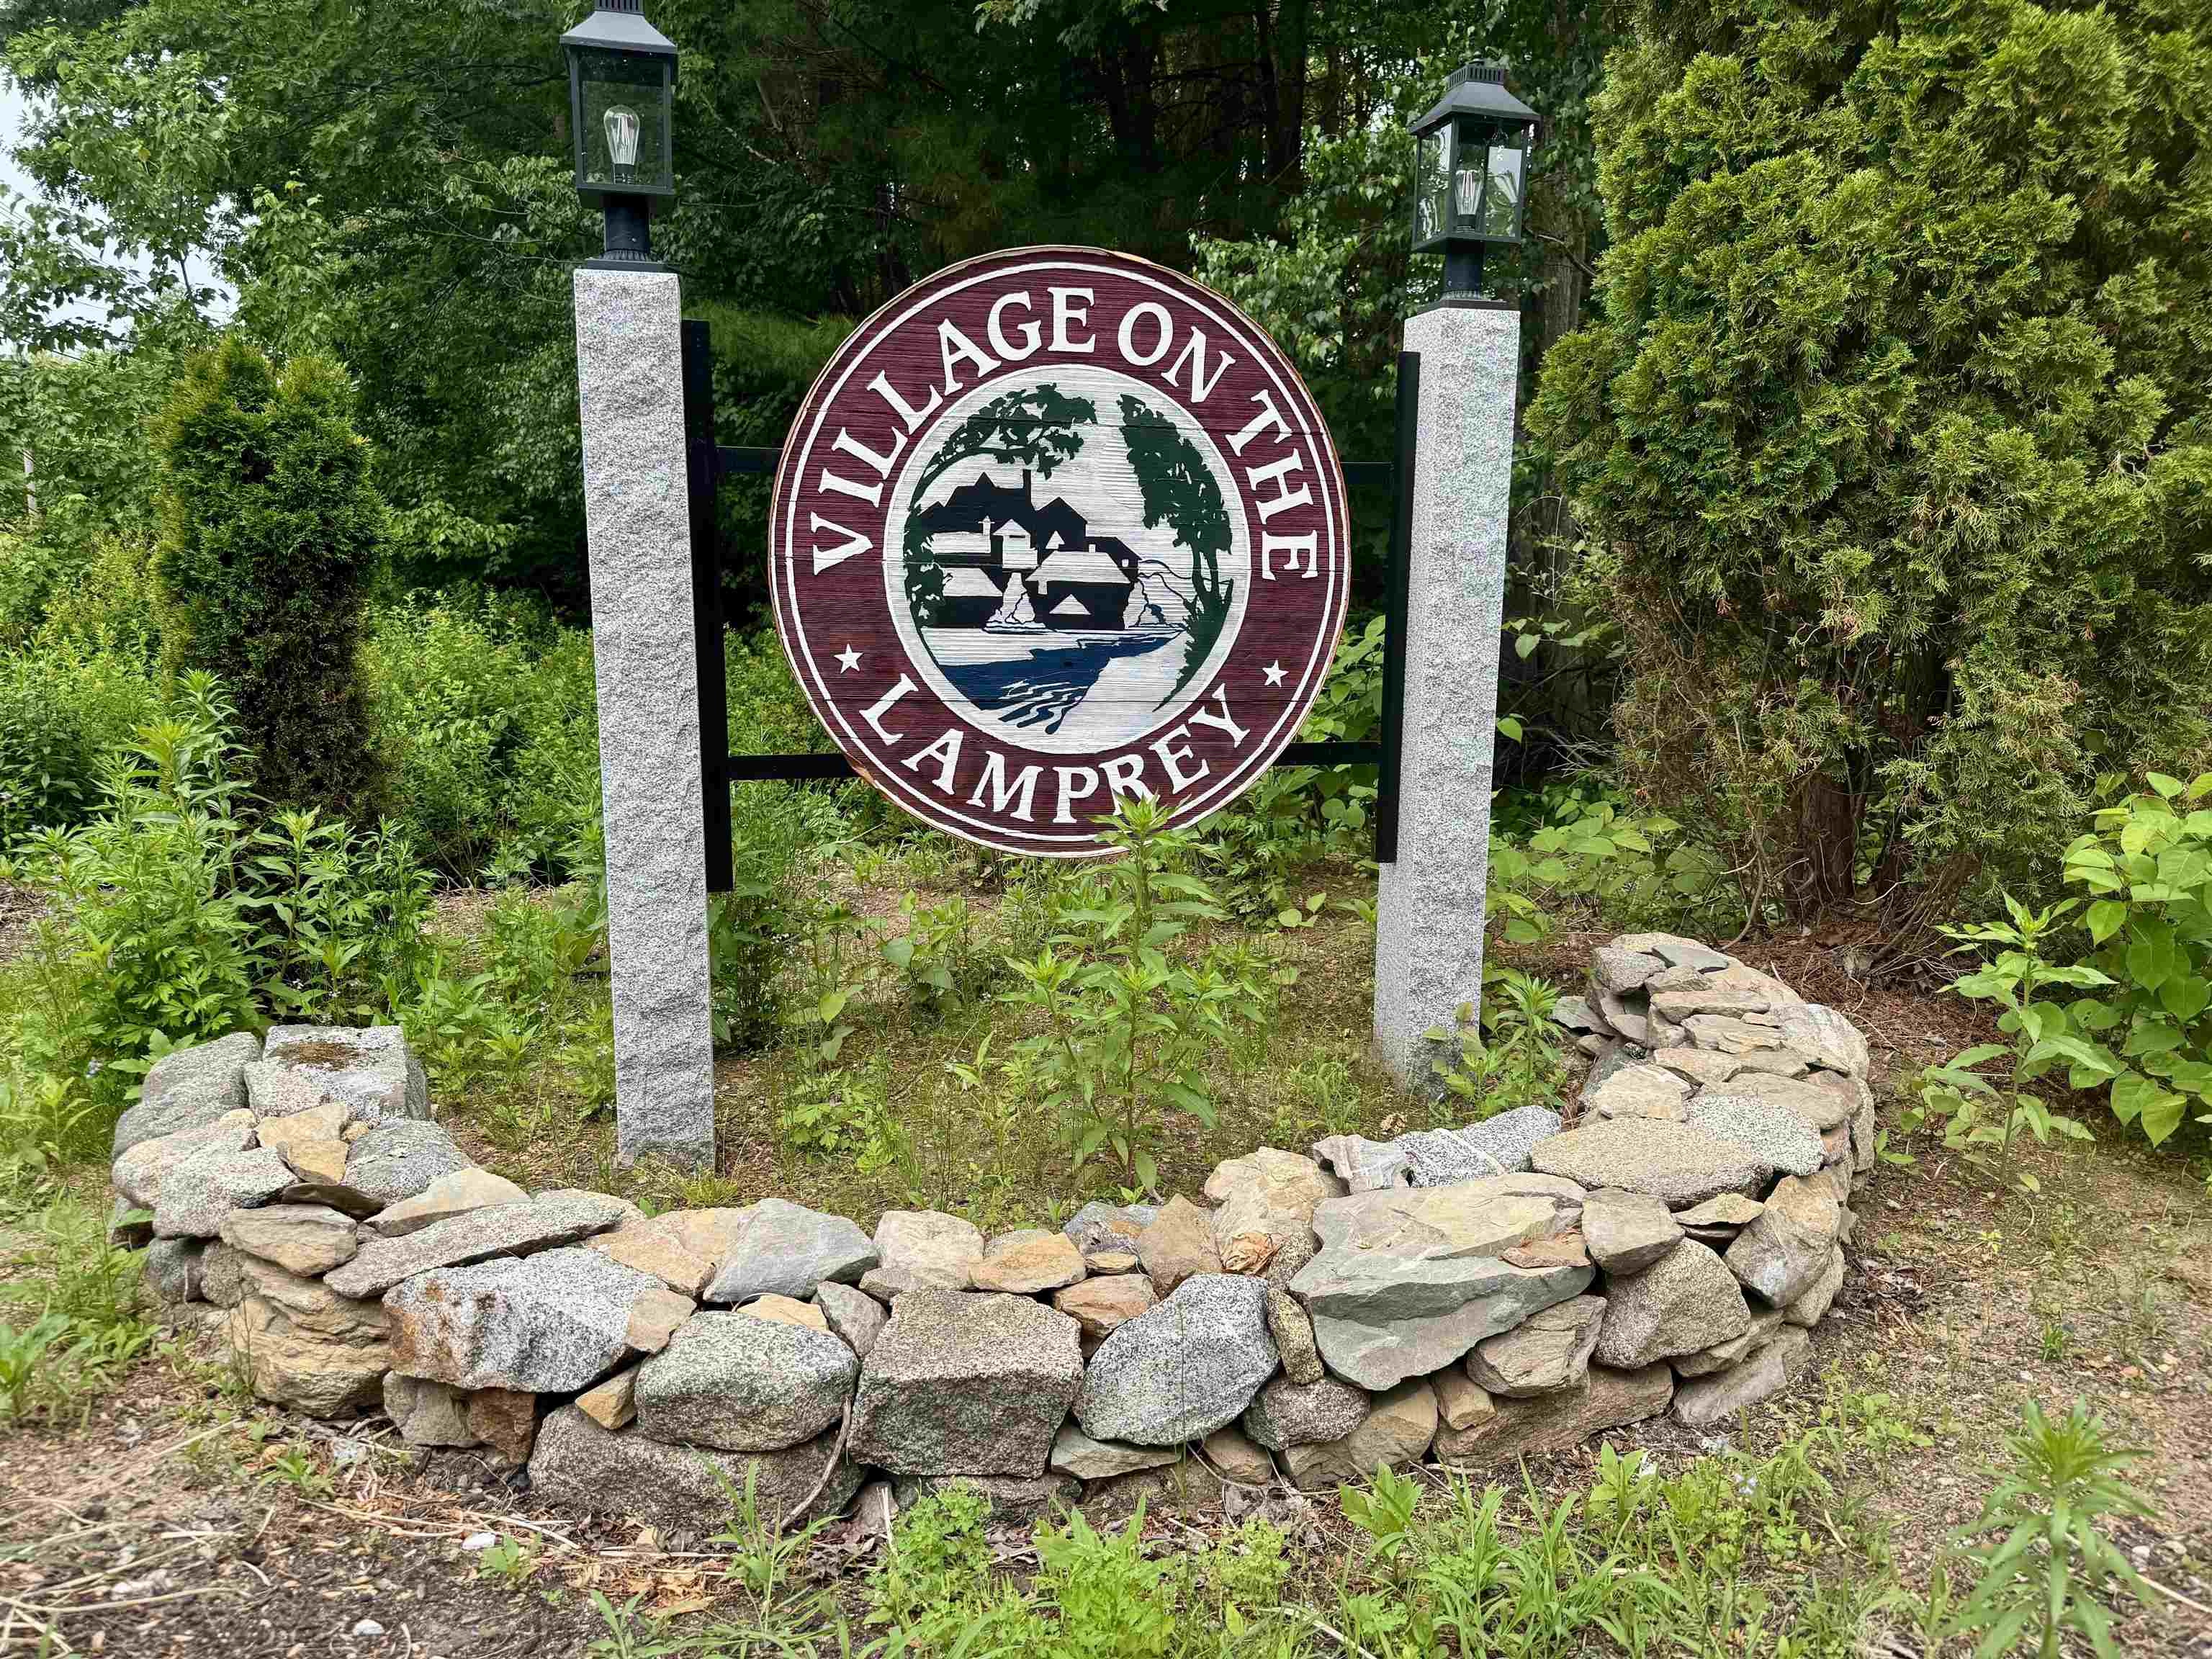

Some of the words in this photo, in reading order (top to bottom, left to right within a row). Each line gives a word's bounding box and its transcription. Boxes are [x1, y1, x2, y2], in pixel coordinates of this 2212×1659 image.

[810, 287, 1095, 575] VILLAGE
[1118, 302, 1236, 404] ON
[1226, 390, 1318, 581] THE
[860, 673, 1250, 823] LAMPREY
